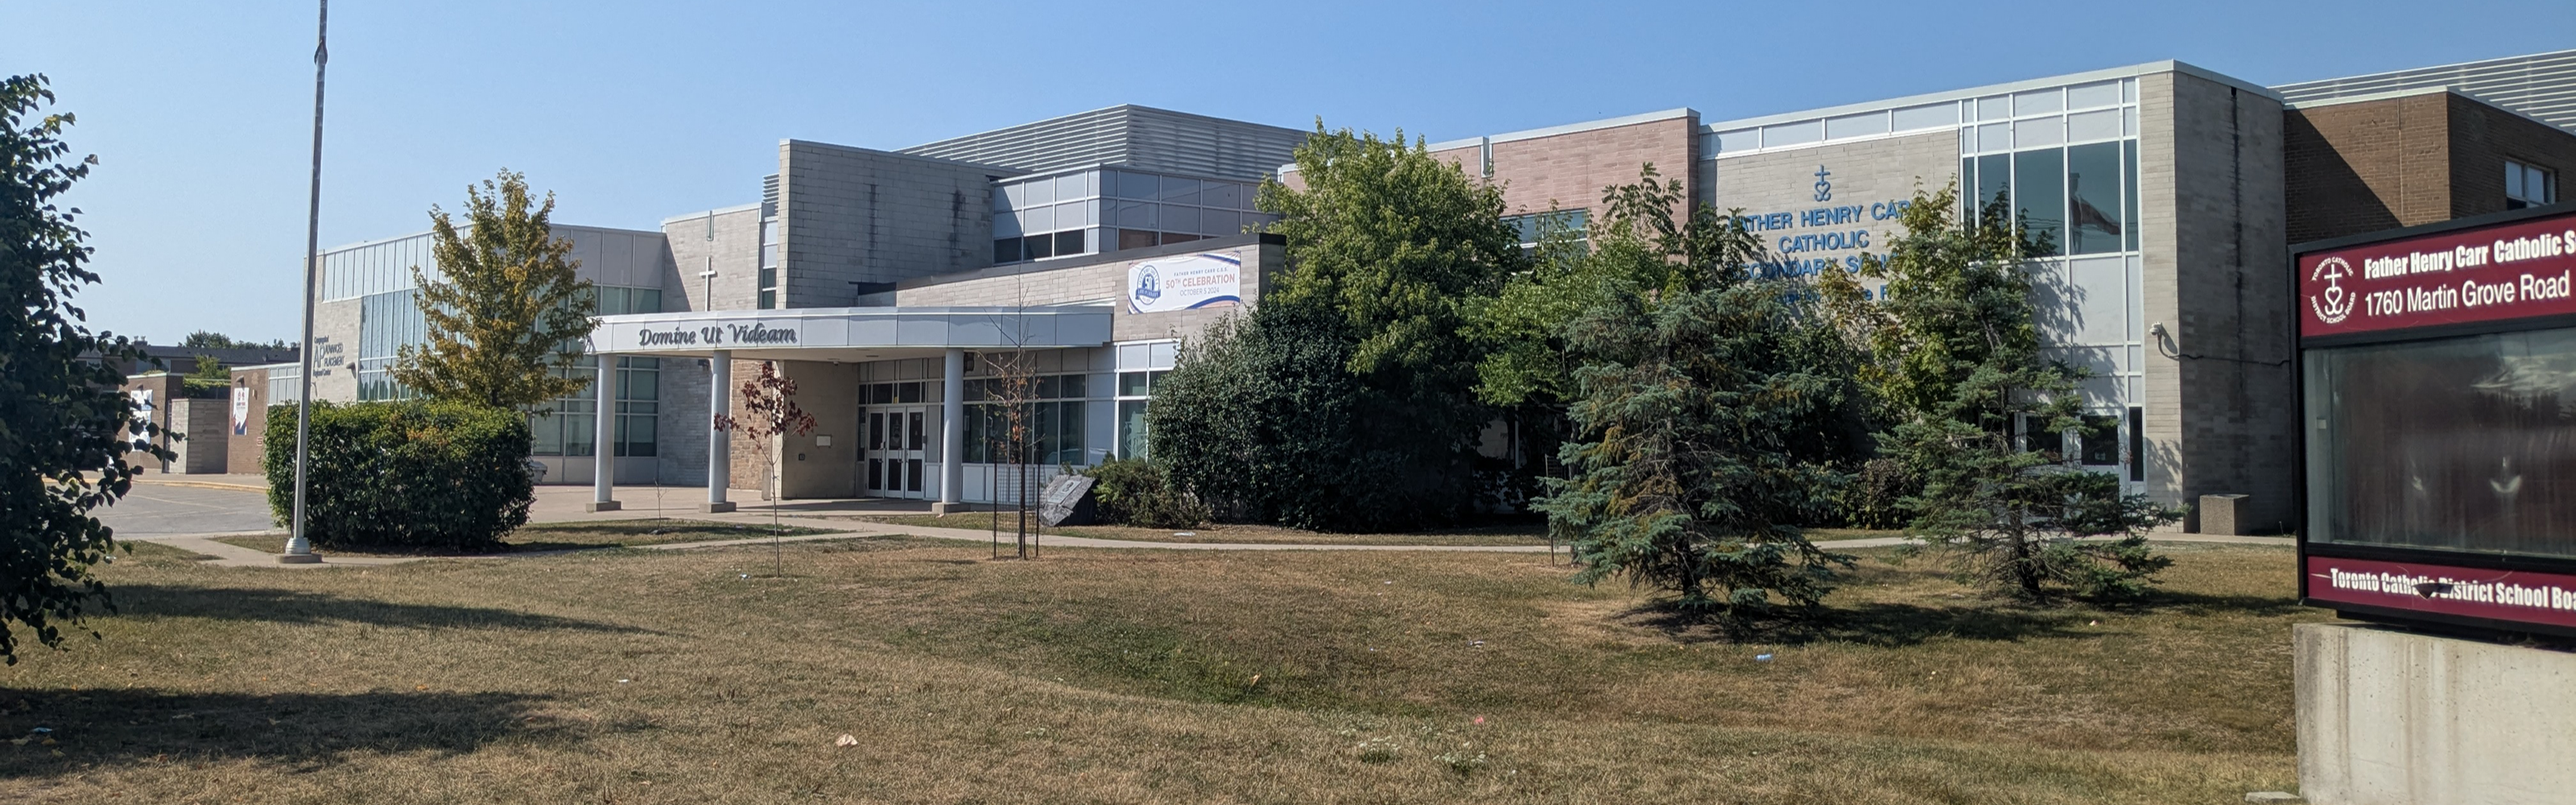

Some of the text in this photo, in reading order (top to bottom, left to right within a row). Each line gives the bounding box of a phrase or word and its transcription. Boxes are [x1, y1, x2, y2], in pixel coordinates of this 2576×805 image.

[1801, 204, 1864, 227] HENRY
[1871, 200, 1912, 221] CAR
[1778, 229, 1869, 254] CATHOLIC
[2364, 229, 2576, 279] Father Henry Carr Catholic S
[1183, 273, 1235, 287] CELEBRATION
[2311, 257, 2354, 281] TORONTO CATHOLIC
[1180, 288, 1203, 296] OCTOBER
[1208, 287, 1220, 295] 2024
[2365, 269, 2570, 316] 1760 Martin Grove Road
[2310, 291, 2356, 324] DISTRICT SCHOOL BOARD
[639, 322, 798, 345] Domine Ut Videam
[314, 345, 326, 368] AP
[2330, 568, 2380, 591] Toronto
[2381, 572, 2436, 598] Catho
[2496, 582, 2549, 608] School
